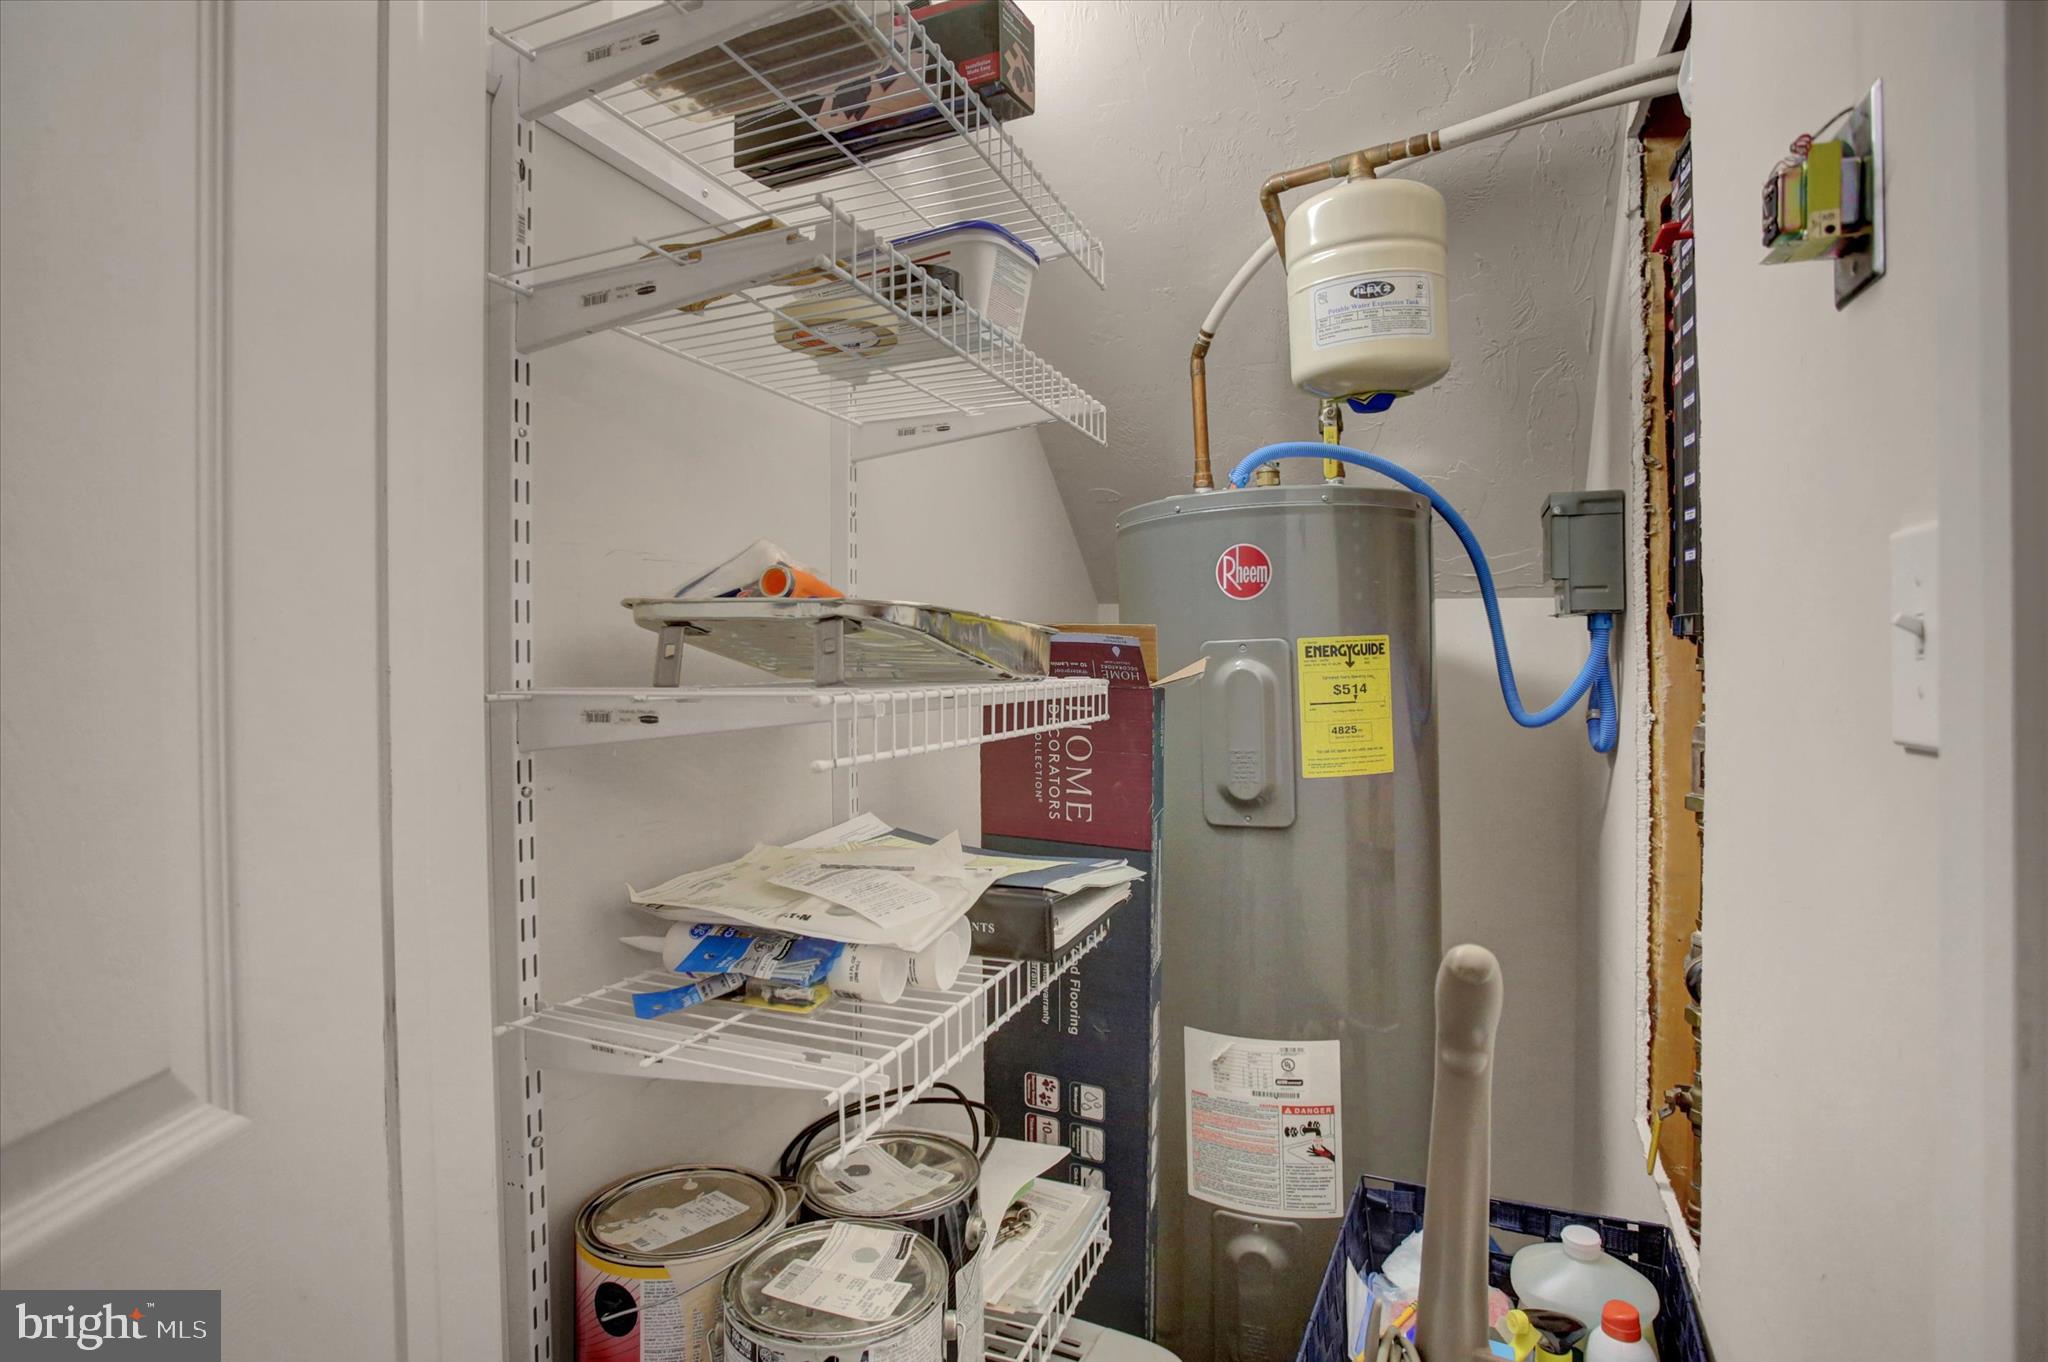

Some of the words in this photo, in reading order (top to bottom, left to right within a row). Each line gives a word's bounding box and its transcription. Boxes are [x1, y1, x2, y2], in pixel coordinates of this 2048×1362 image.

[1328, 305, 1350, 315] Potable
[1351, 302, 1370, 310] Water
[1372, 299, 1405, 307] Expansion
[1223, 546, 1268, 591] Rheem
[1305, 642, 1386, 658] ENERGYGUIDE
[1101, 669, 1140, 681] HOME
[1333, 683, 1367, 696] $514
[1331, 725, 1358, 734] 4825
[1068, 980, 1081, 1036] Flooring
